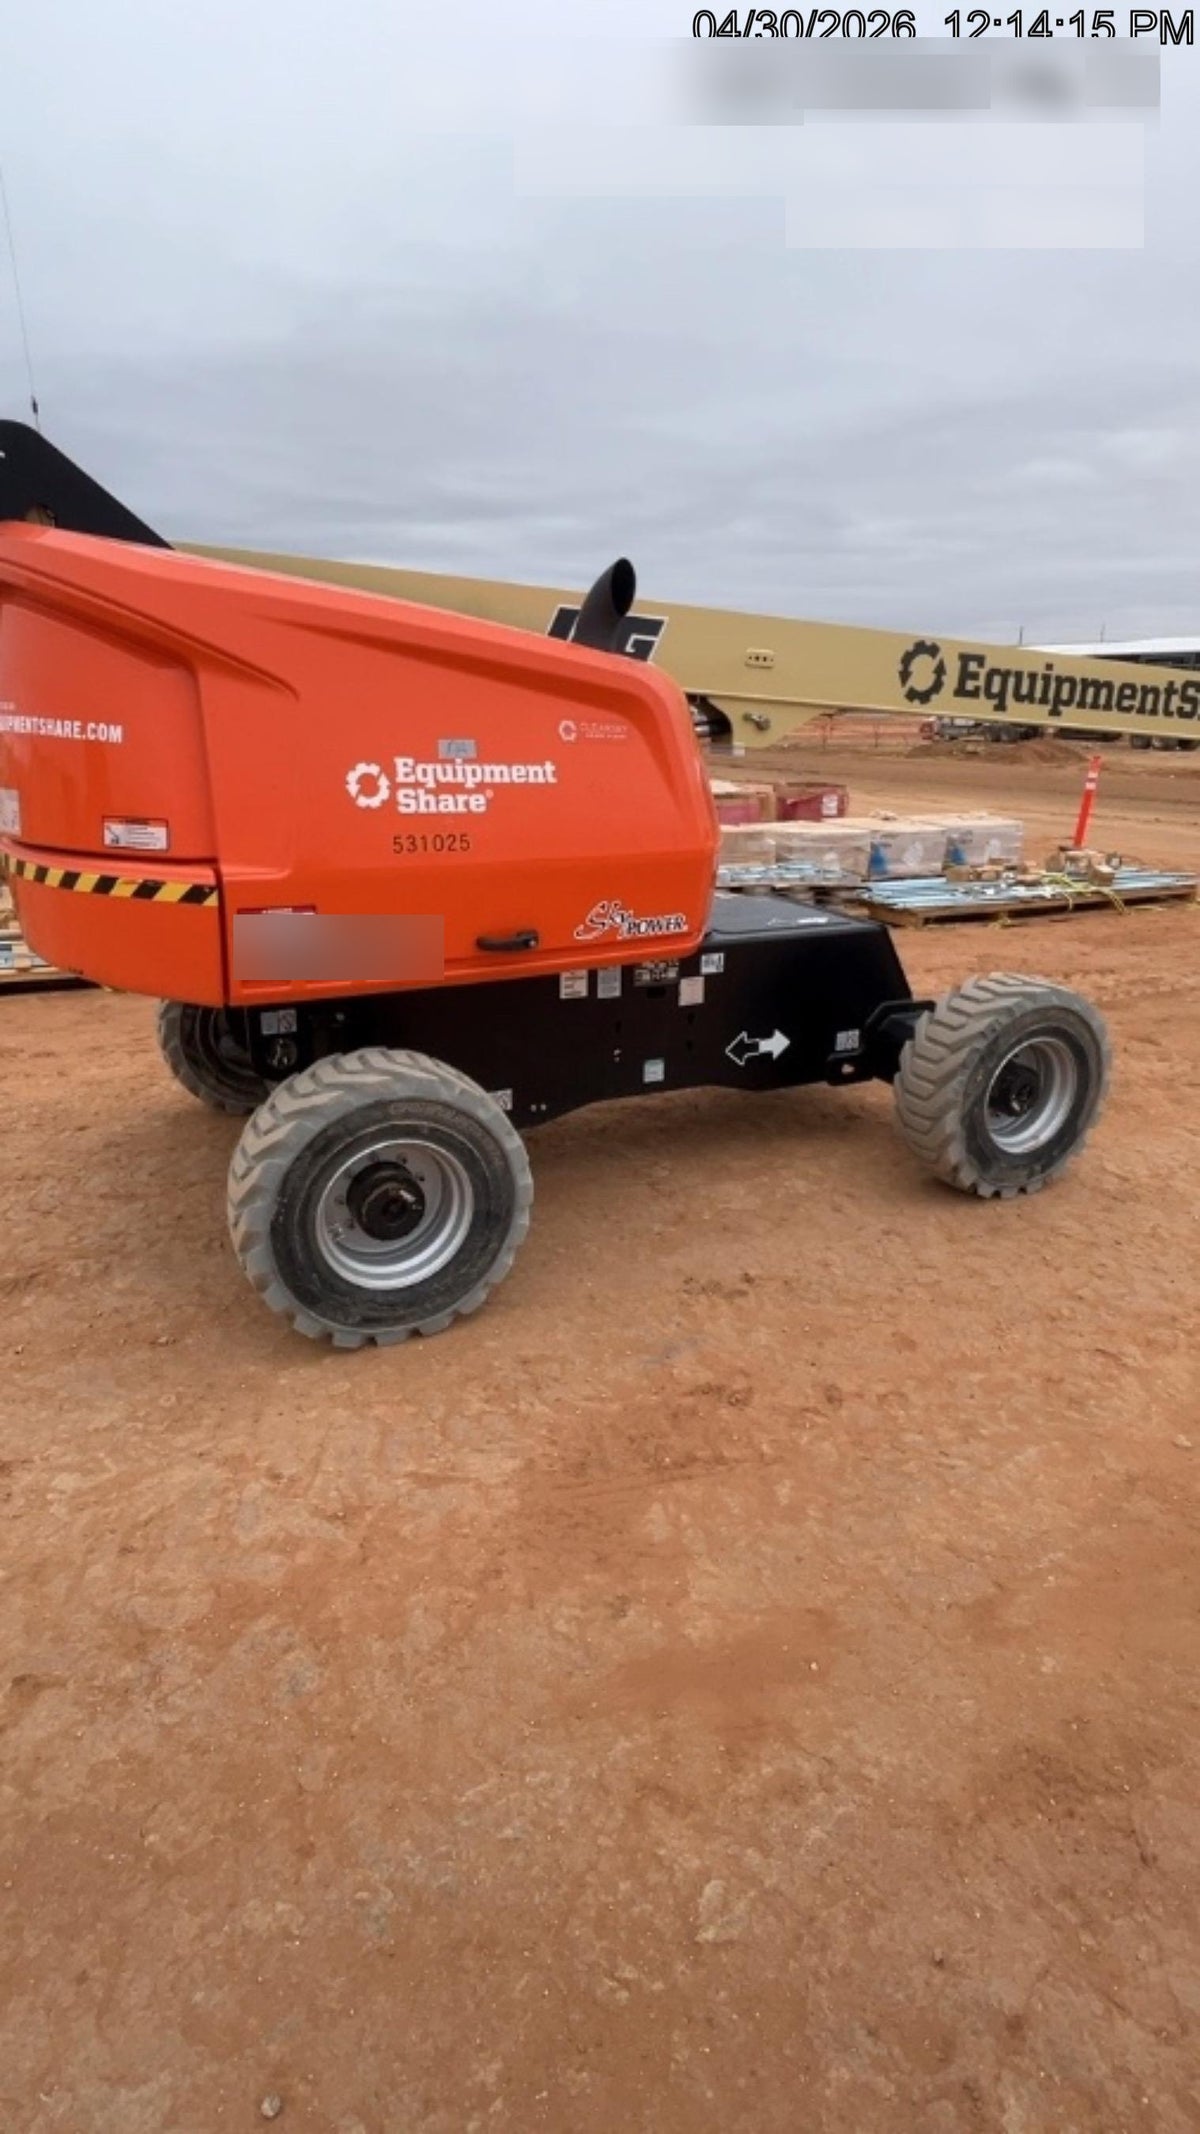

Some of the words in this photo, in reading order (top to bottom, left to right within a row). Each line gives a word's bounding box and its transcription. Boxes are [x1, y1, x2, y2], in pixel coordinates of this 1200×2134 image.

[953, 651, 1200, 720] EquipmentS
[394, 757, 558, 788] Equipment
[393, 833, 471, 855] 531025
